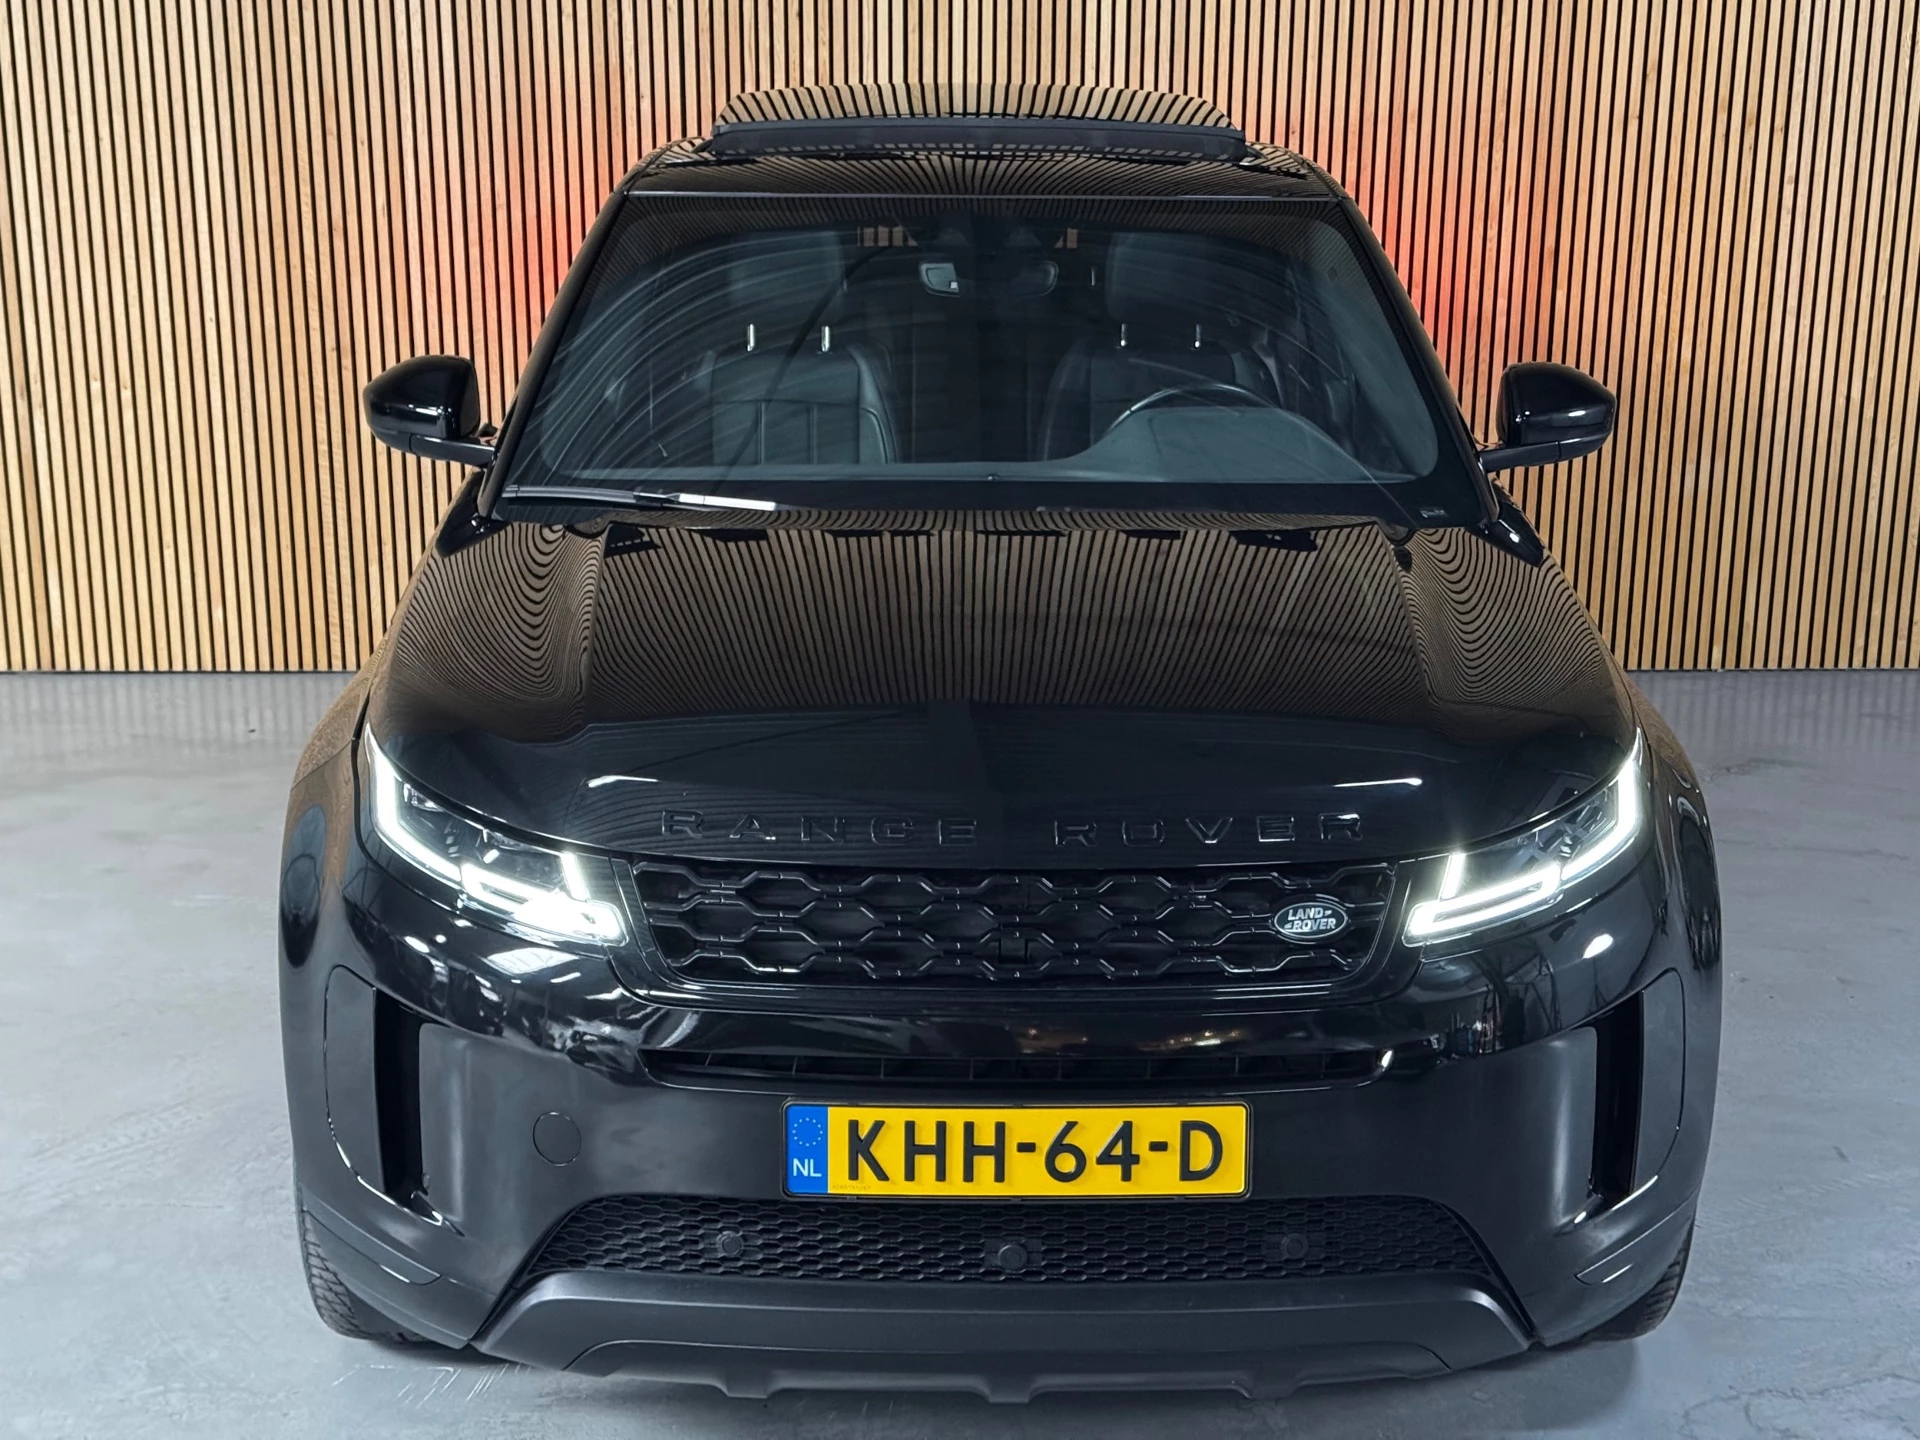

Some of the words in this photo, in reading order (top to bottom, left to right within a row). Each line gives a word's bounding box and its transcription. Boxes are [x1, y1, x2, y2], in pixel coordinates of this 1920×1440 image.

[661, 808, 978, 847] RANGE
[1053, 812, 1364, 847] ROVER
[1292, 918, 1336, 931] ROVER
[847, 1119, 1223, 1183] KHH-64-D
[792, 1158, 822, 1177] NL
